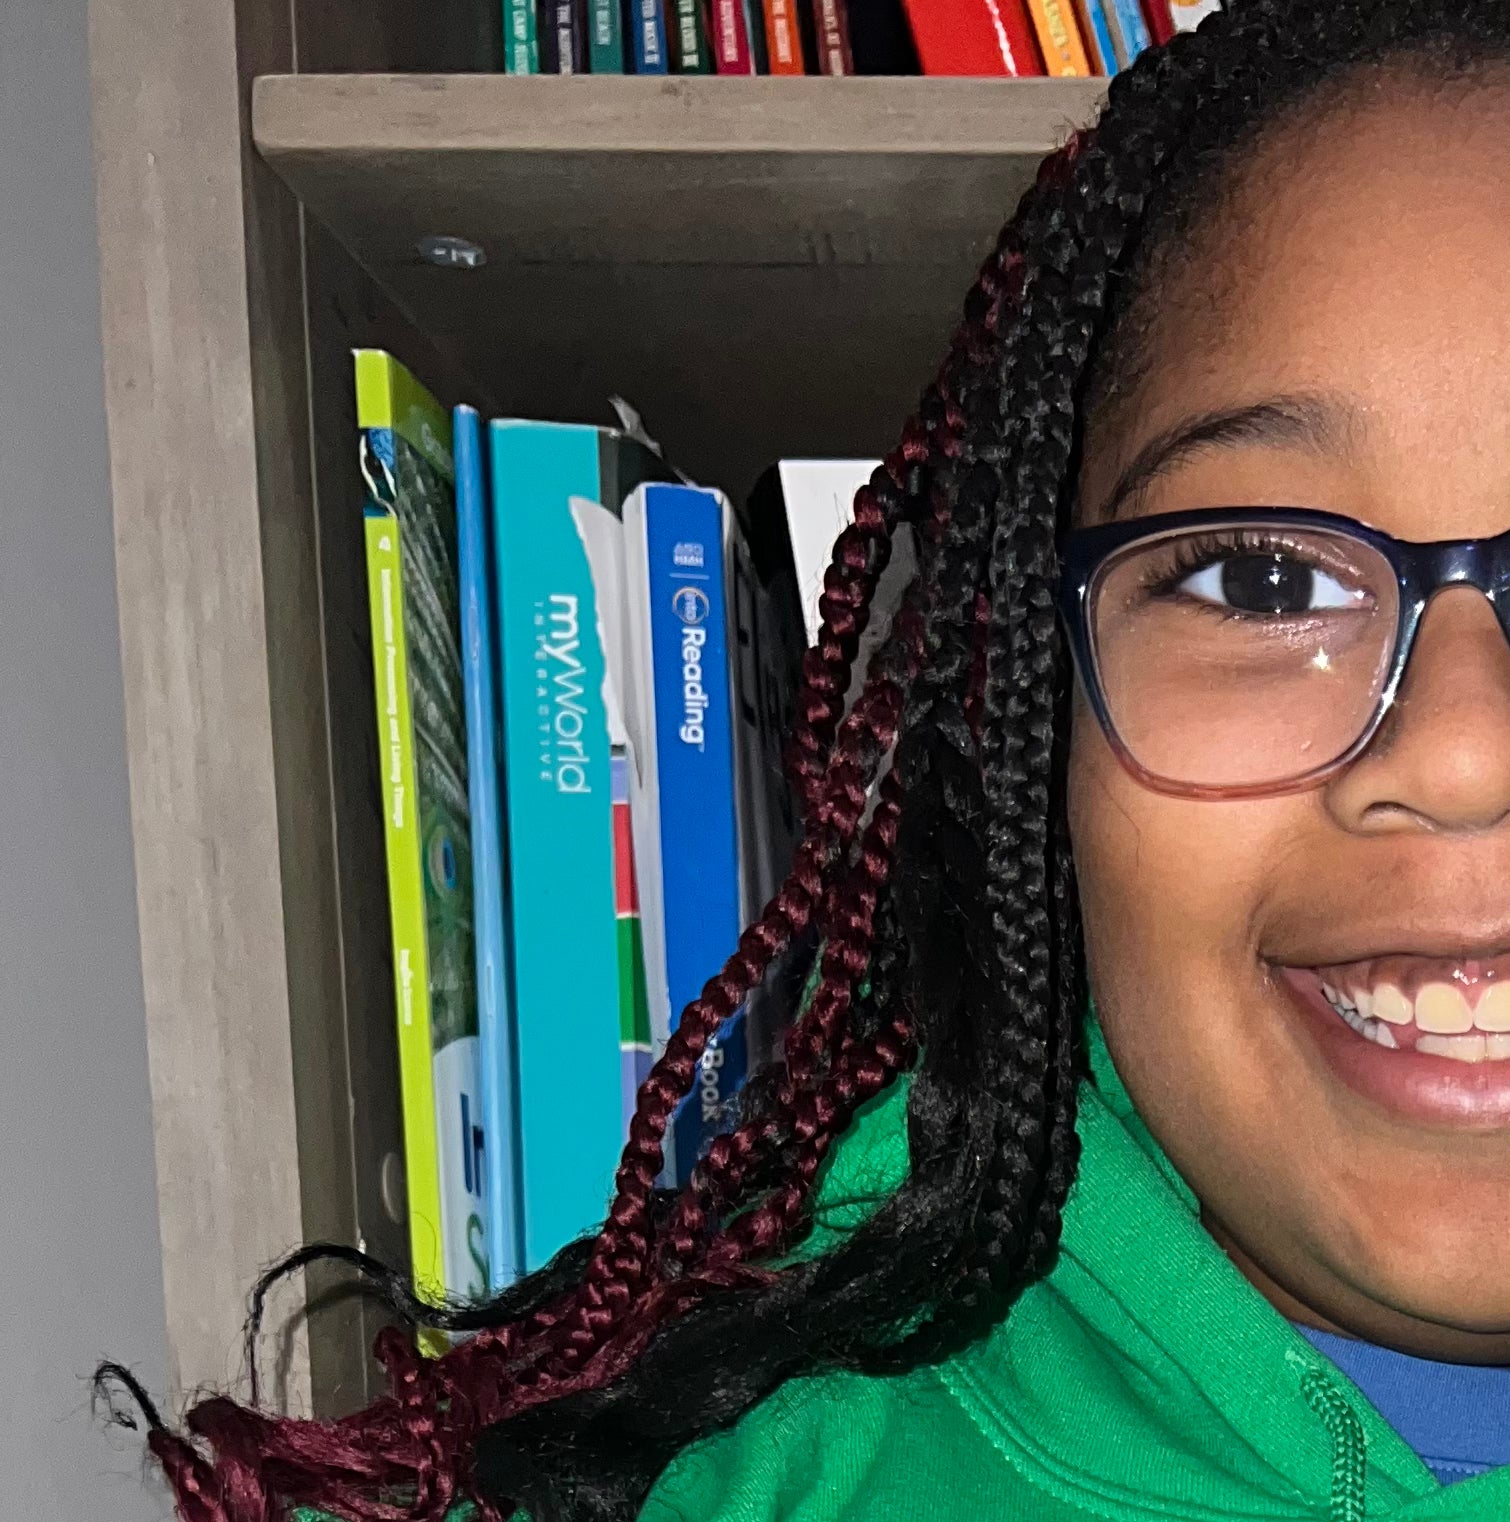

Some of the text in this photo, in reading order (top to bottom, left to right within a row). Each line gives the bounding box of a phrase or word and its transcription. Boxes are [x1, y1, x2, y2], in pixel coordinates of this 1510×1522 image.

[533, 600, 552, 783] INTERACTIVE
[541, 593, 592, 795] myWorld
[679, 628, 709, 745] Reading
